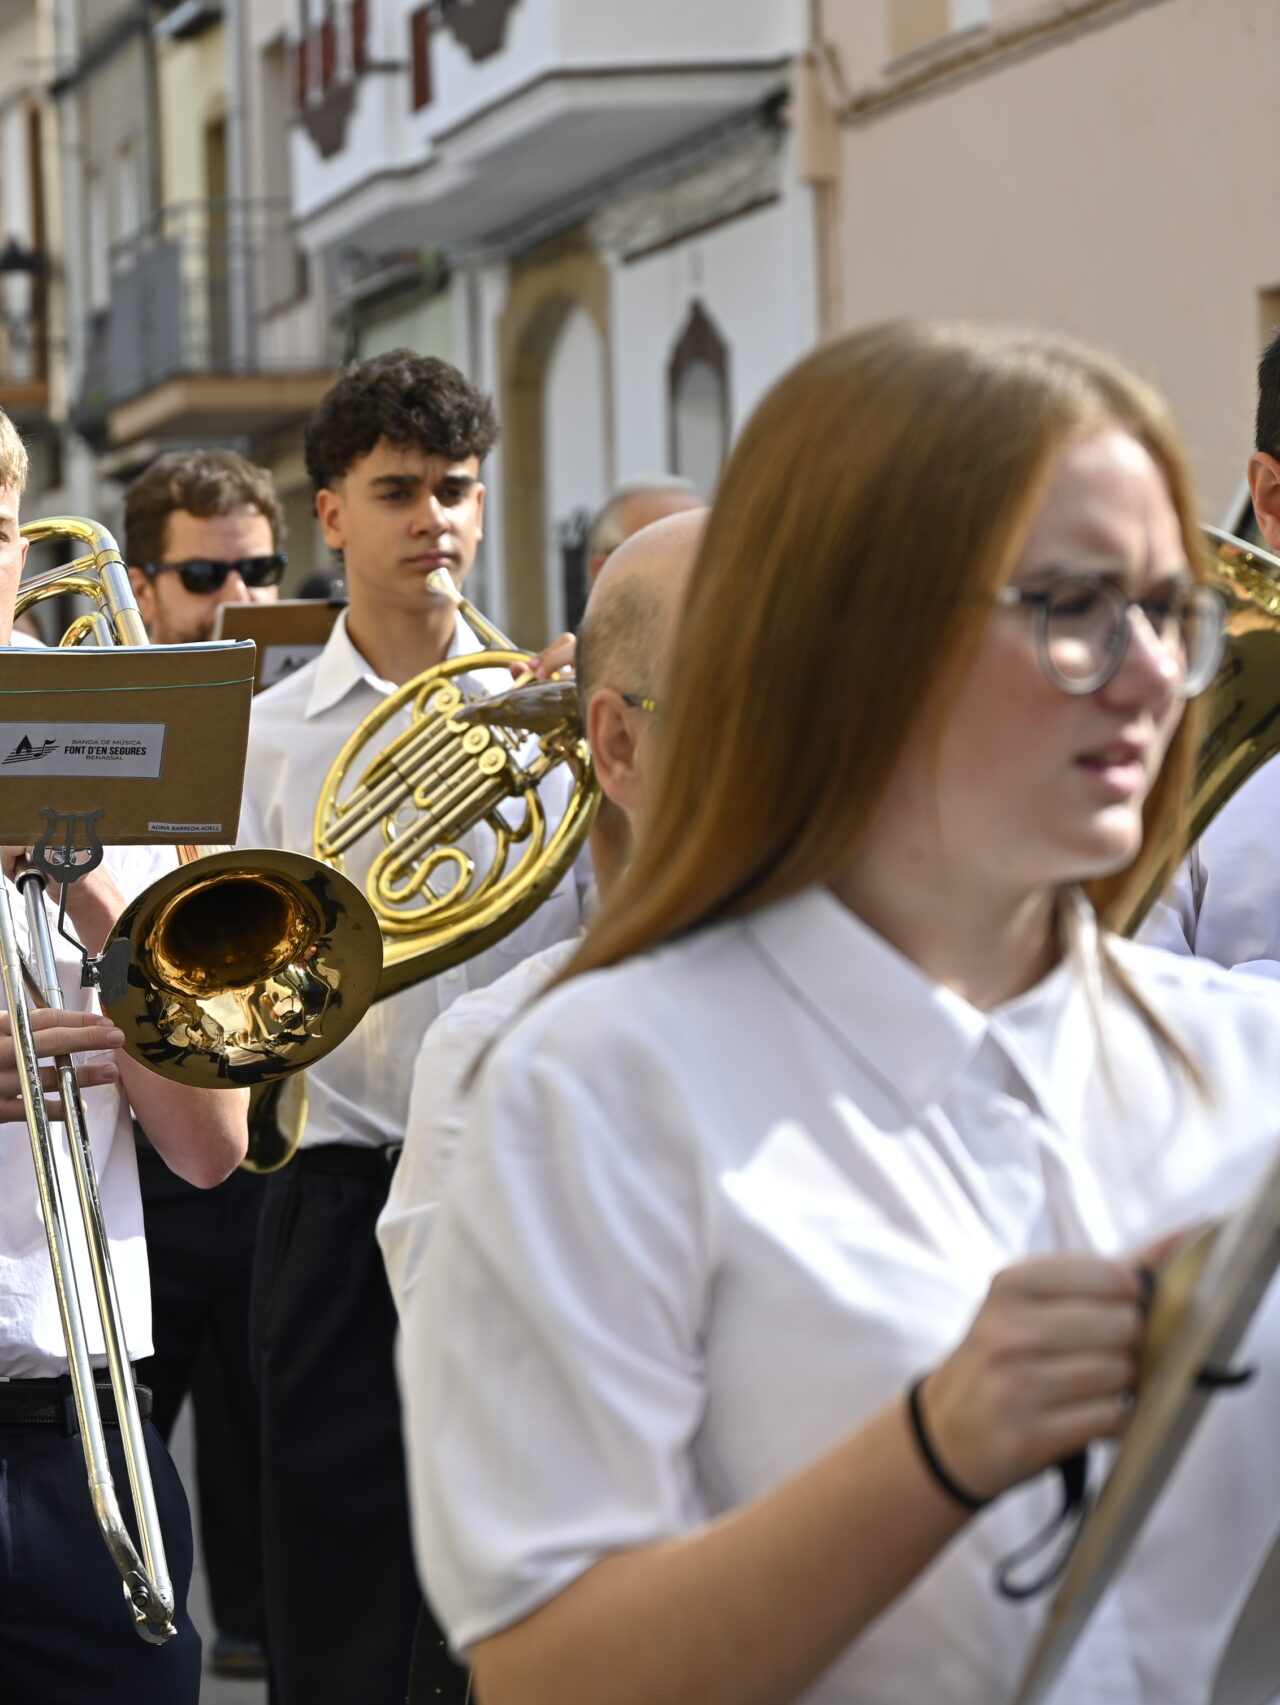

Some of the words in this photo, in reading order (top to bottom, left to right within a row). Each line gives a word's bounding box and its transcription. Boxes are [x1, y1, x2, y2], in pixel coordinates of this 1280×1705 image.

[64, 746, 86, 755] FONT
[87, 746, 107, 755] D'EN
[109, 746, 147, 756] SEGURES
